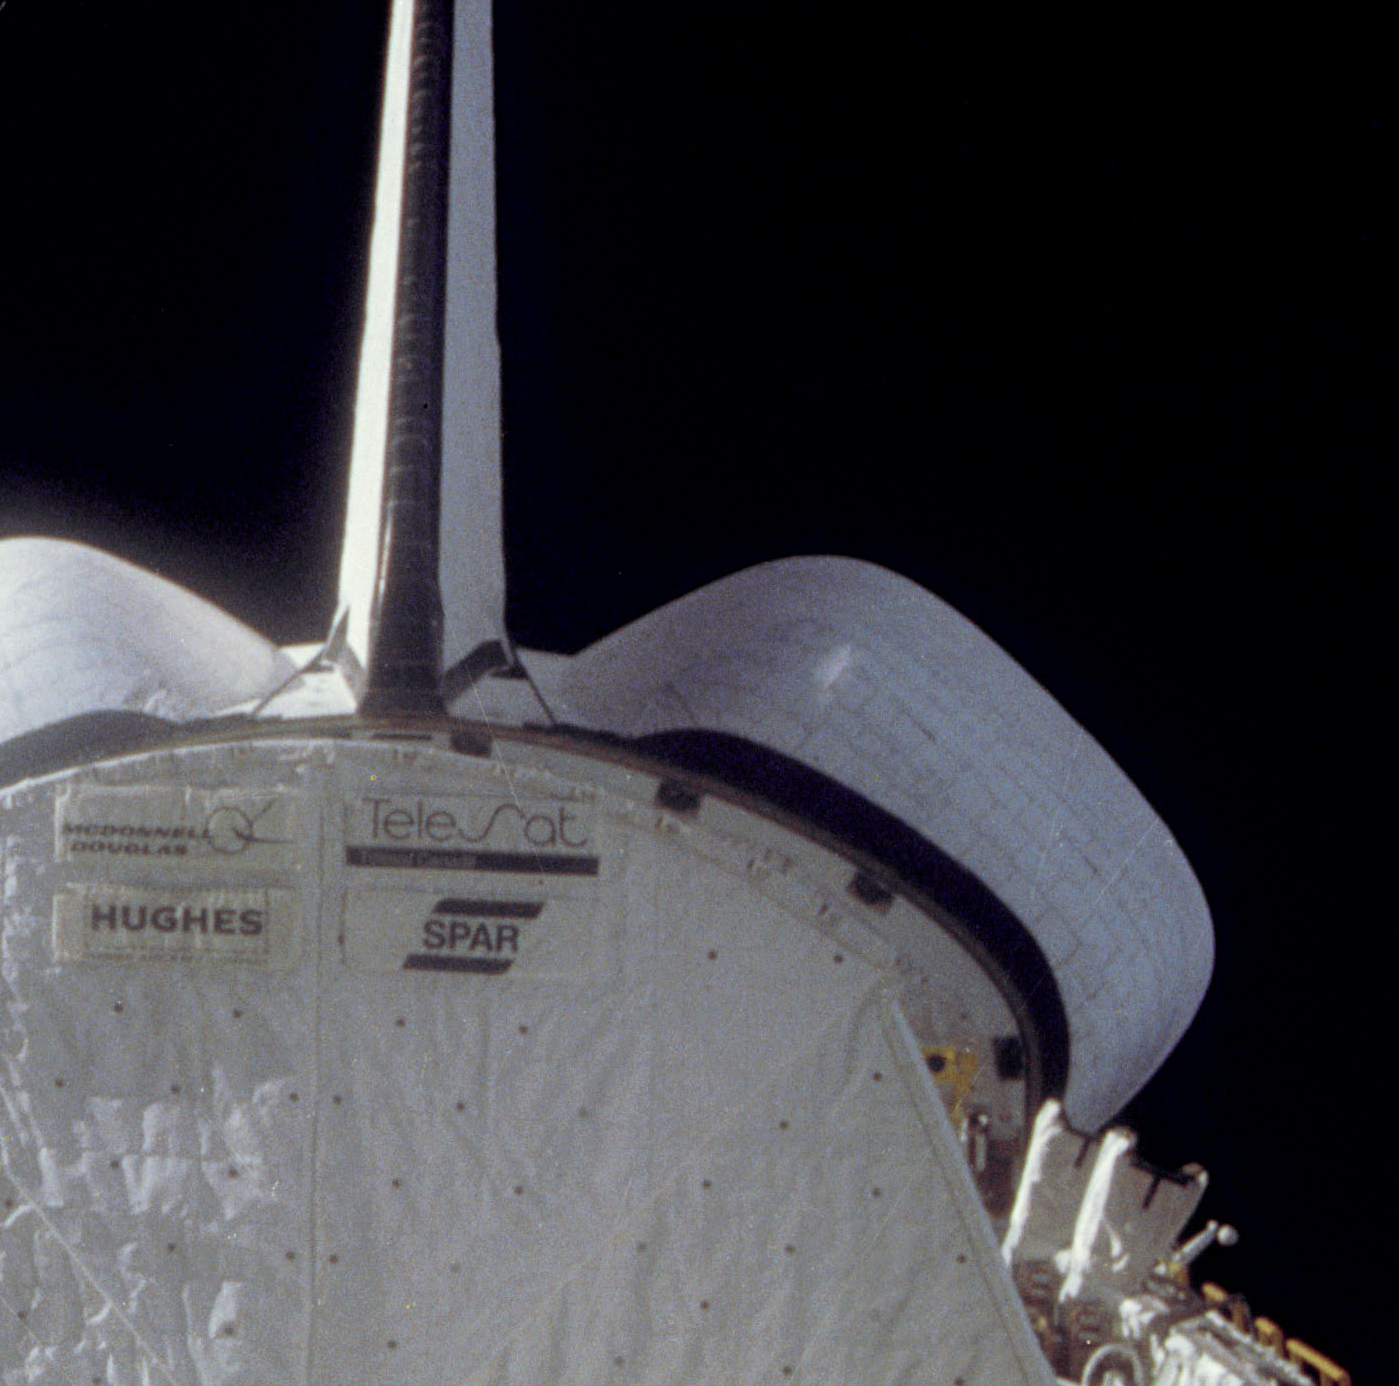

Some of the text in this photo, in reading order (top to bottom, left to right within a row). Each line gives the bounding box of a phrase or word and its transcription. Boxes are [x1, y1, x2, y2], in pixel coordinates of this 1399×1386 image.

[70, 840, 188, 855] DOUGLAS
[91, 904, 264, 936] HUGHES
[423, 919, 520, 953] SPAR
